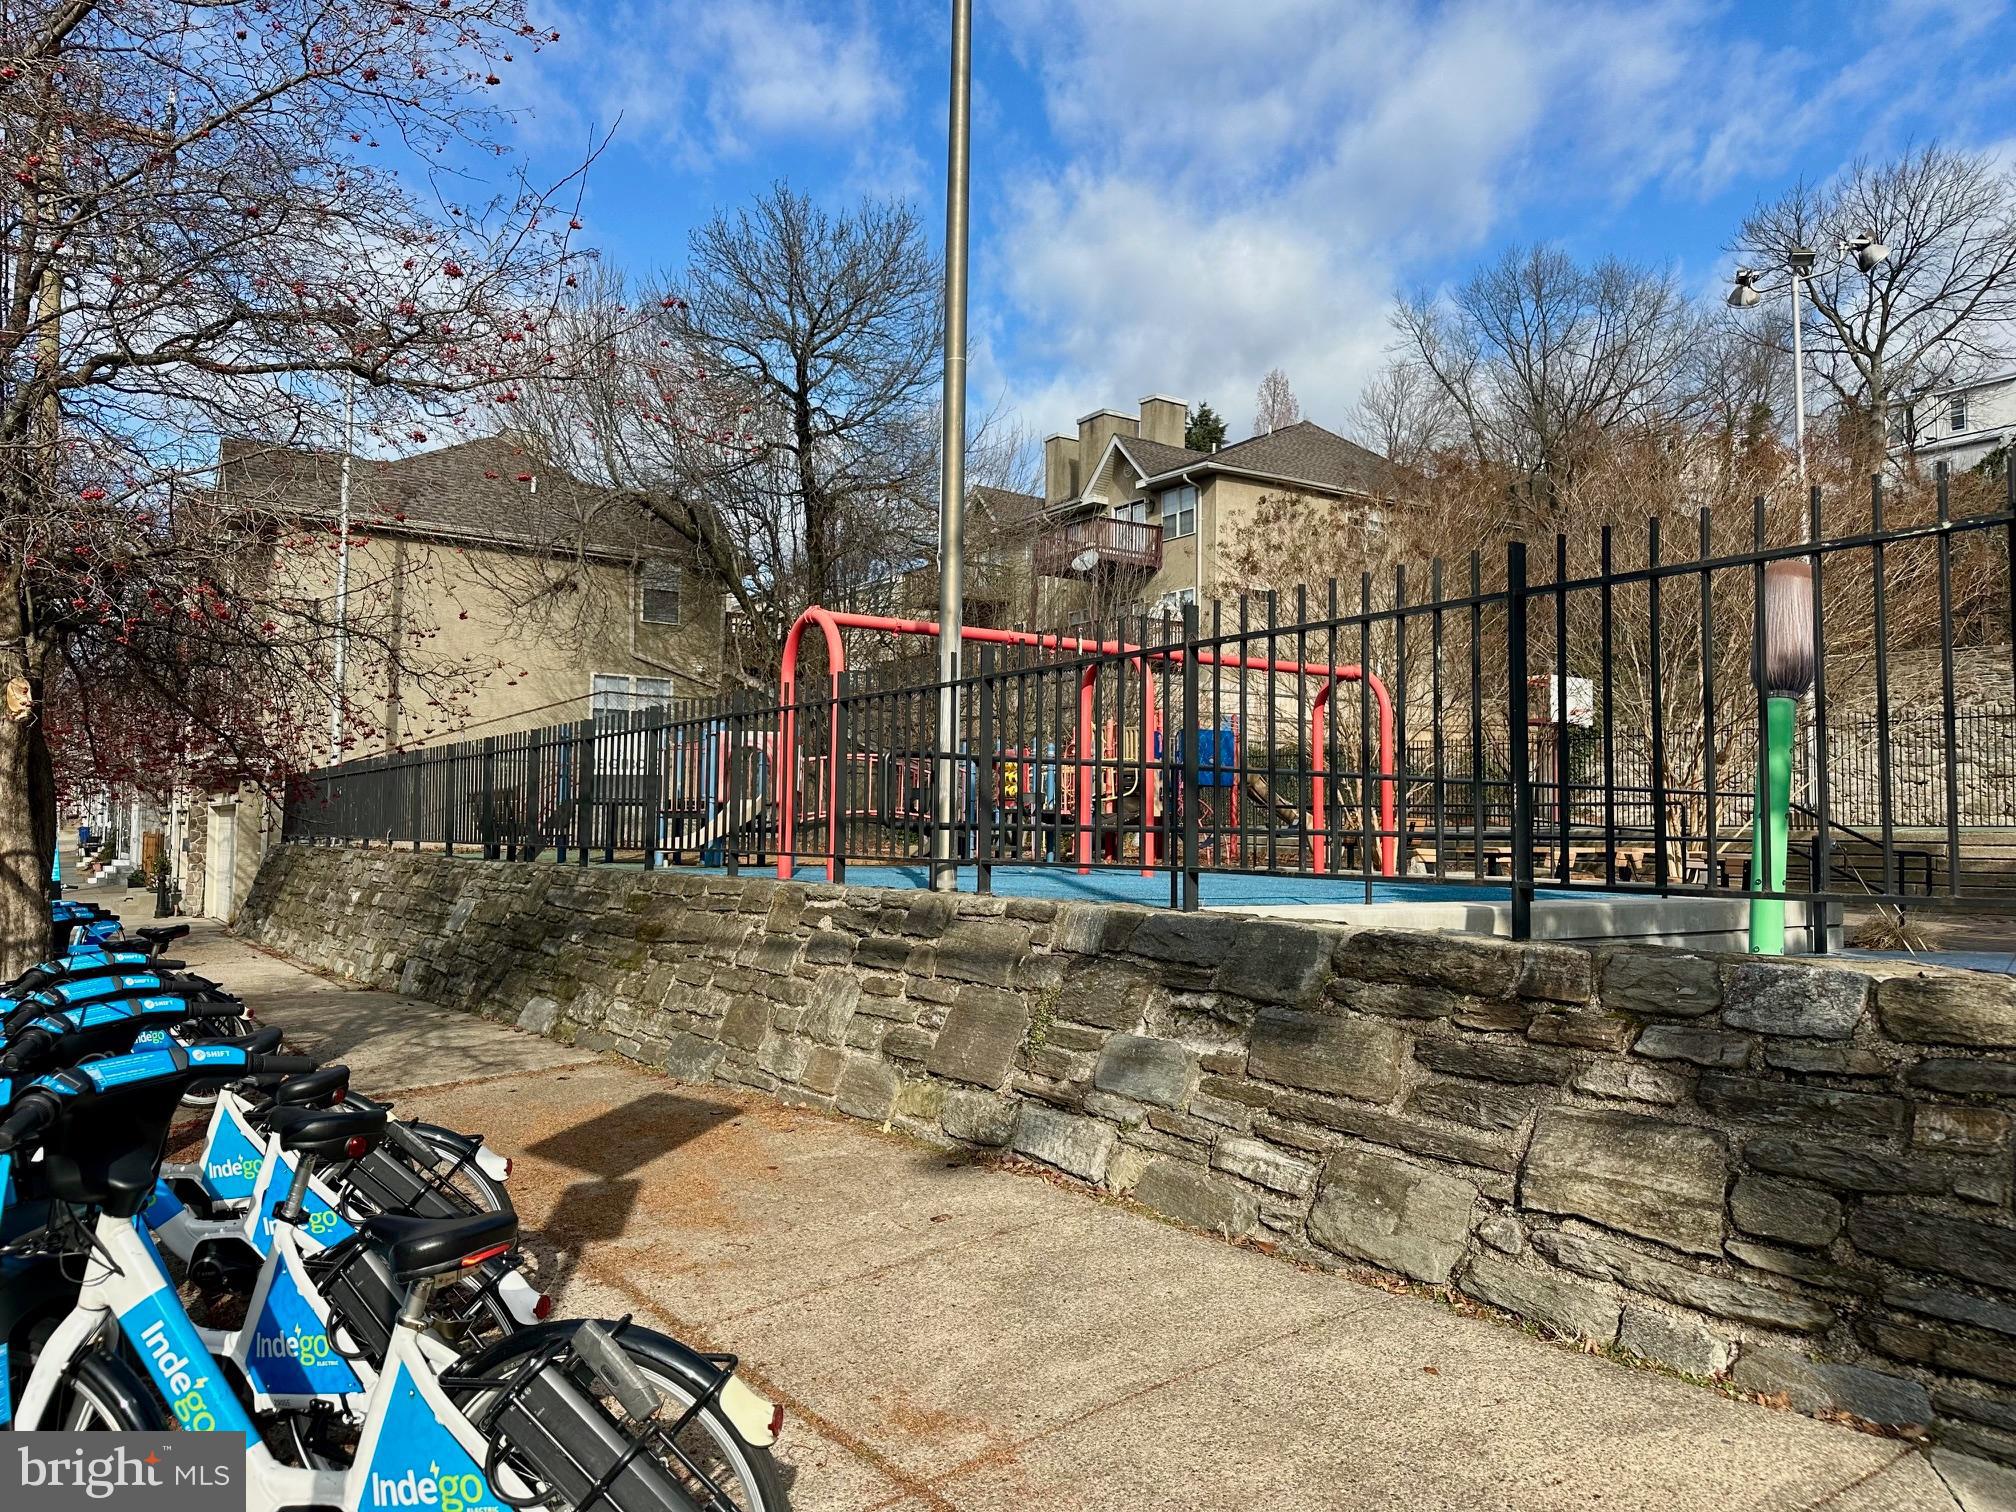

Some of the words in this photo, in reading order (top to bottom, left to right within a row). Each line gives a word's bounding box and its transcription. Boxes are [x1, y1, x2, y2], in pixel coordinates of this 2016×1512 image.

[205, 1050, 230, 1058] SHIFT
[256, 1329, 330, 1367] Indego
[141, 1319, 216, 1431] Indego
[371, 1468, 484, 1512] Indego
